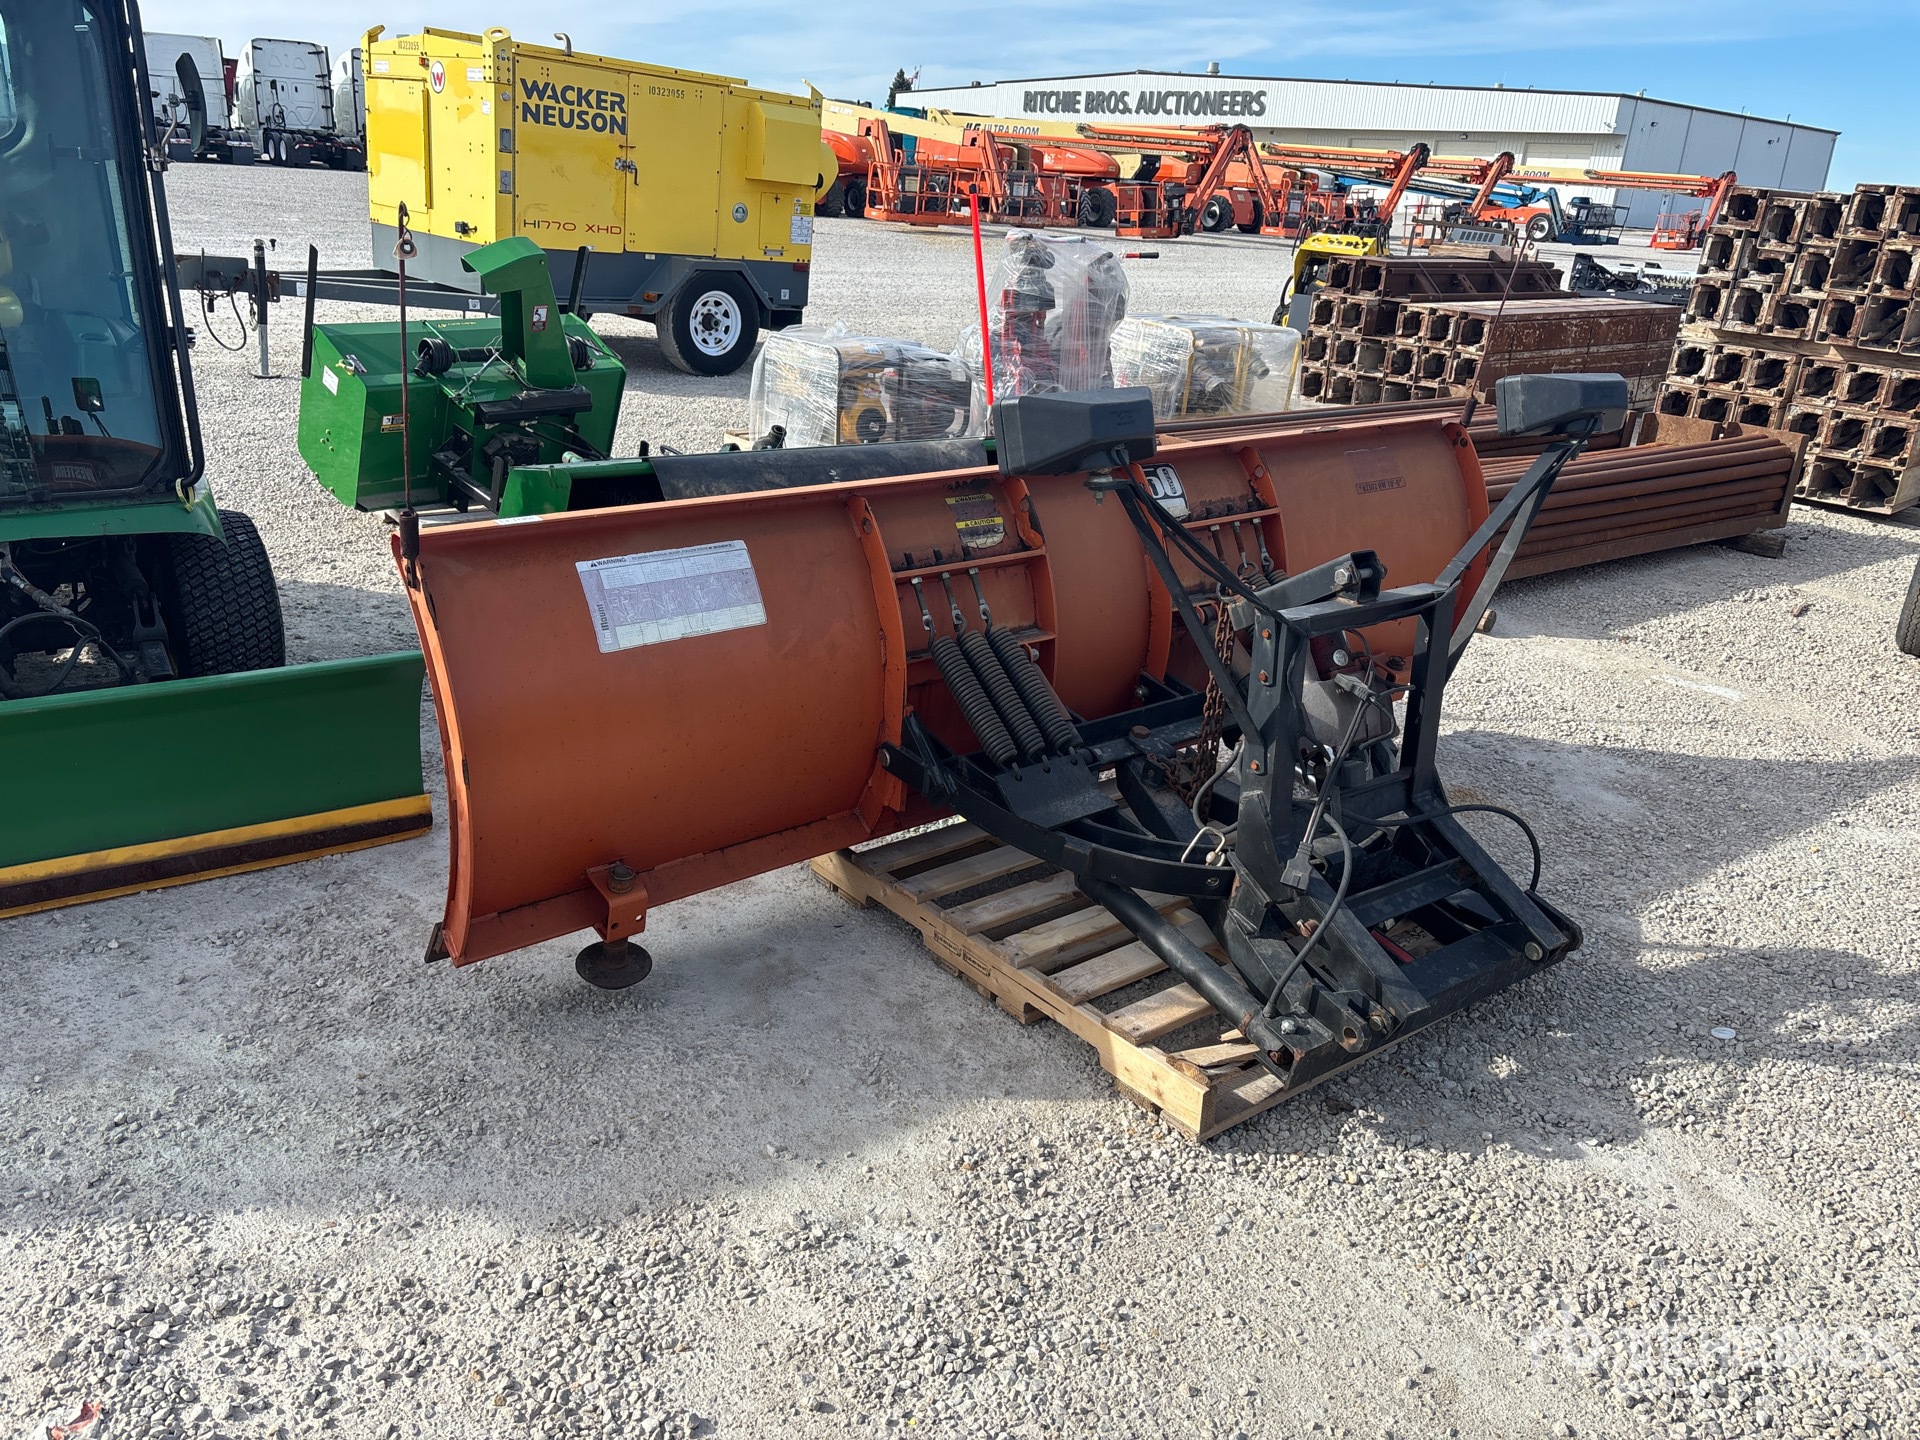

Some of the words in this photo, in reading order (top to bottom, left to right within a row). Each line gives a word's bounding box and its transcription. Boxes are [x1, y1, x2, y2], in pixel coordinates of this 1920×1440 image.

[398, 40, 419, 50] 10323055
[520, 78, 626, 113] WACKER
[648, 86, 685, 99] 10323055
[1023, 90, 1081, 114] RITCHIE
[1084, 91, 1132, 115] BROS.
[1135, 90, 1267, 116] AUCTIONEERS
[522, 102, 626, 135] NEUSON
[1012, 126, 1040, 136] BOOM
[523, 219, 576, 231] HI770
[585, 224, 622, 234] XHD
[596, 557, 627, 566] WARNING
